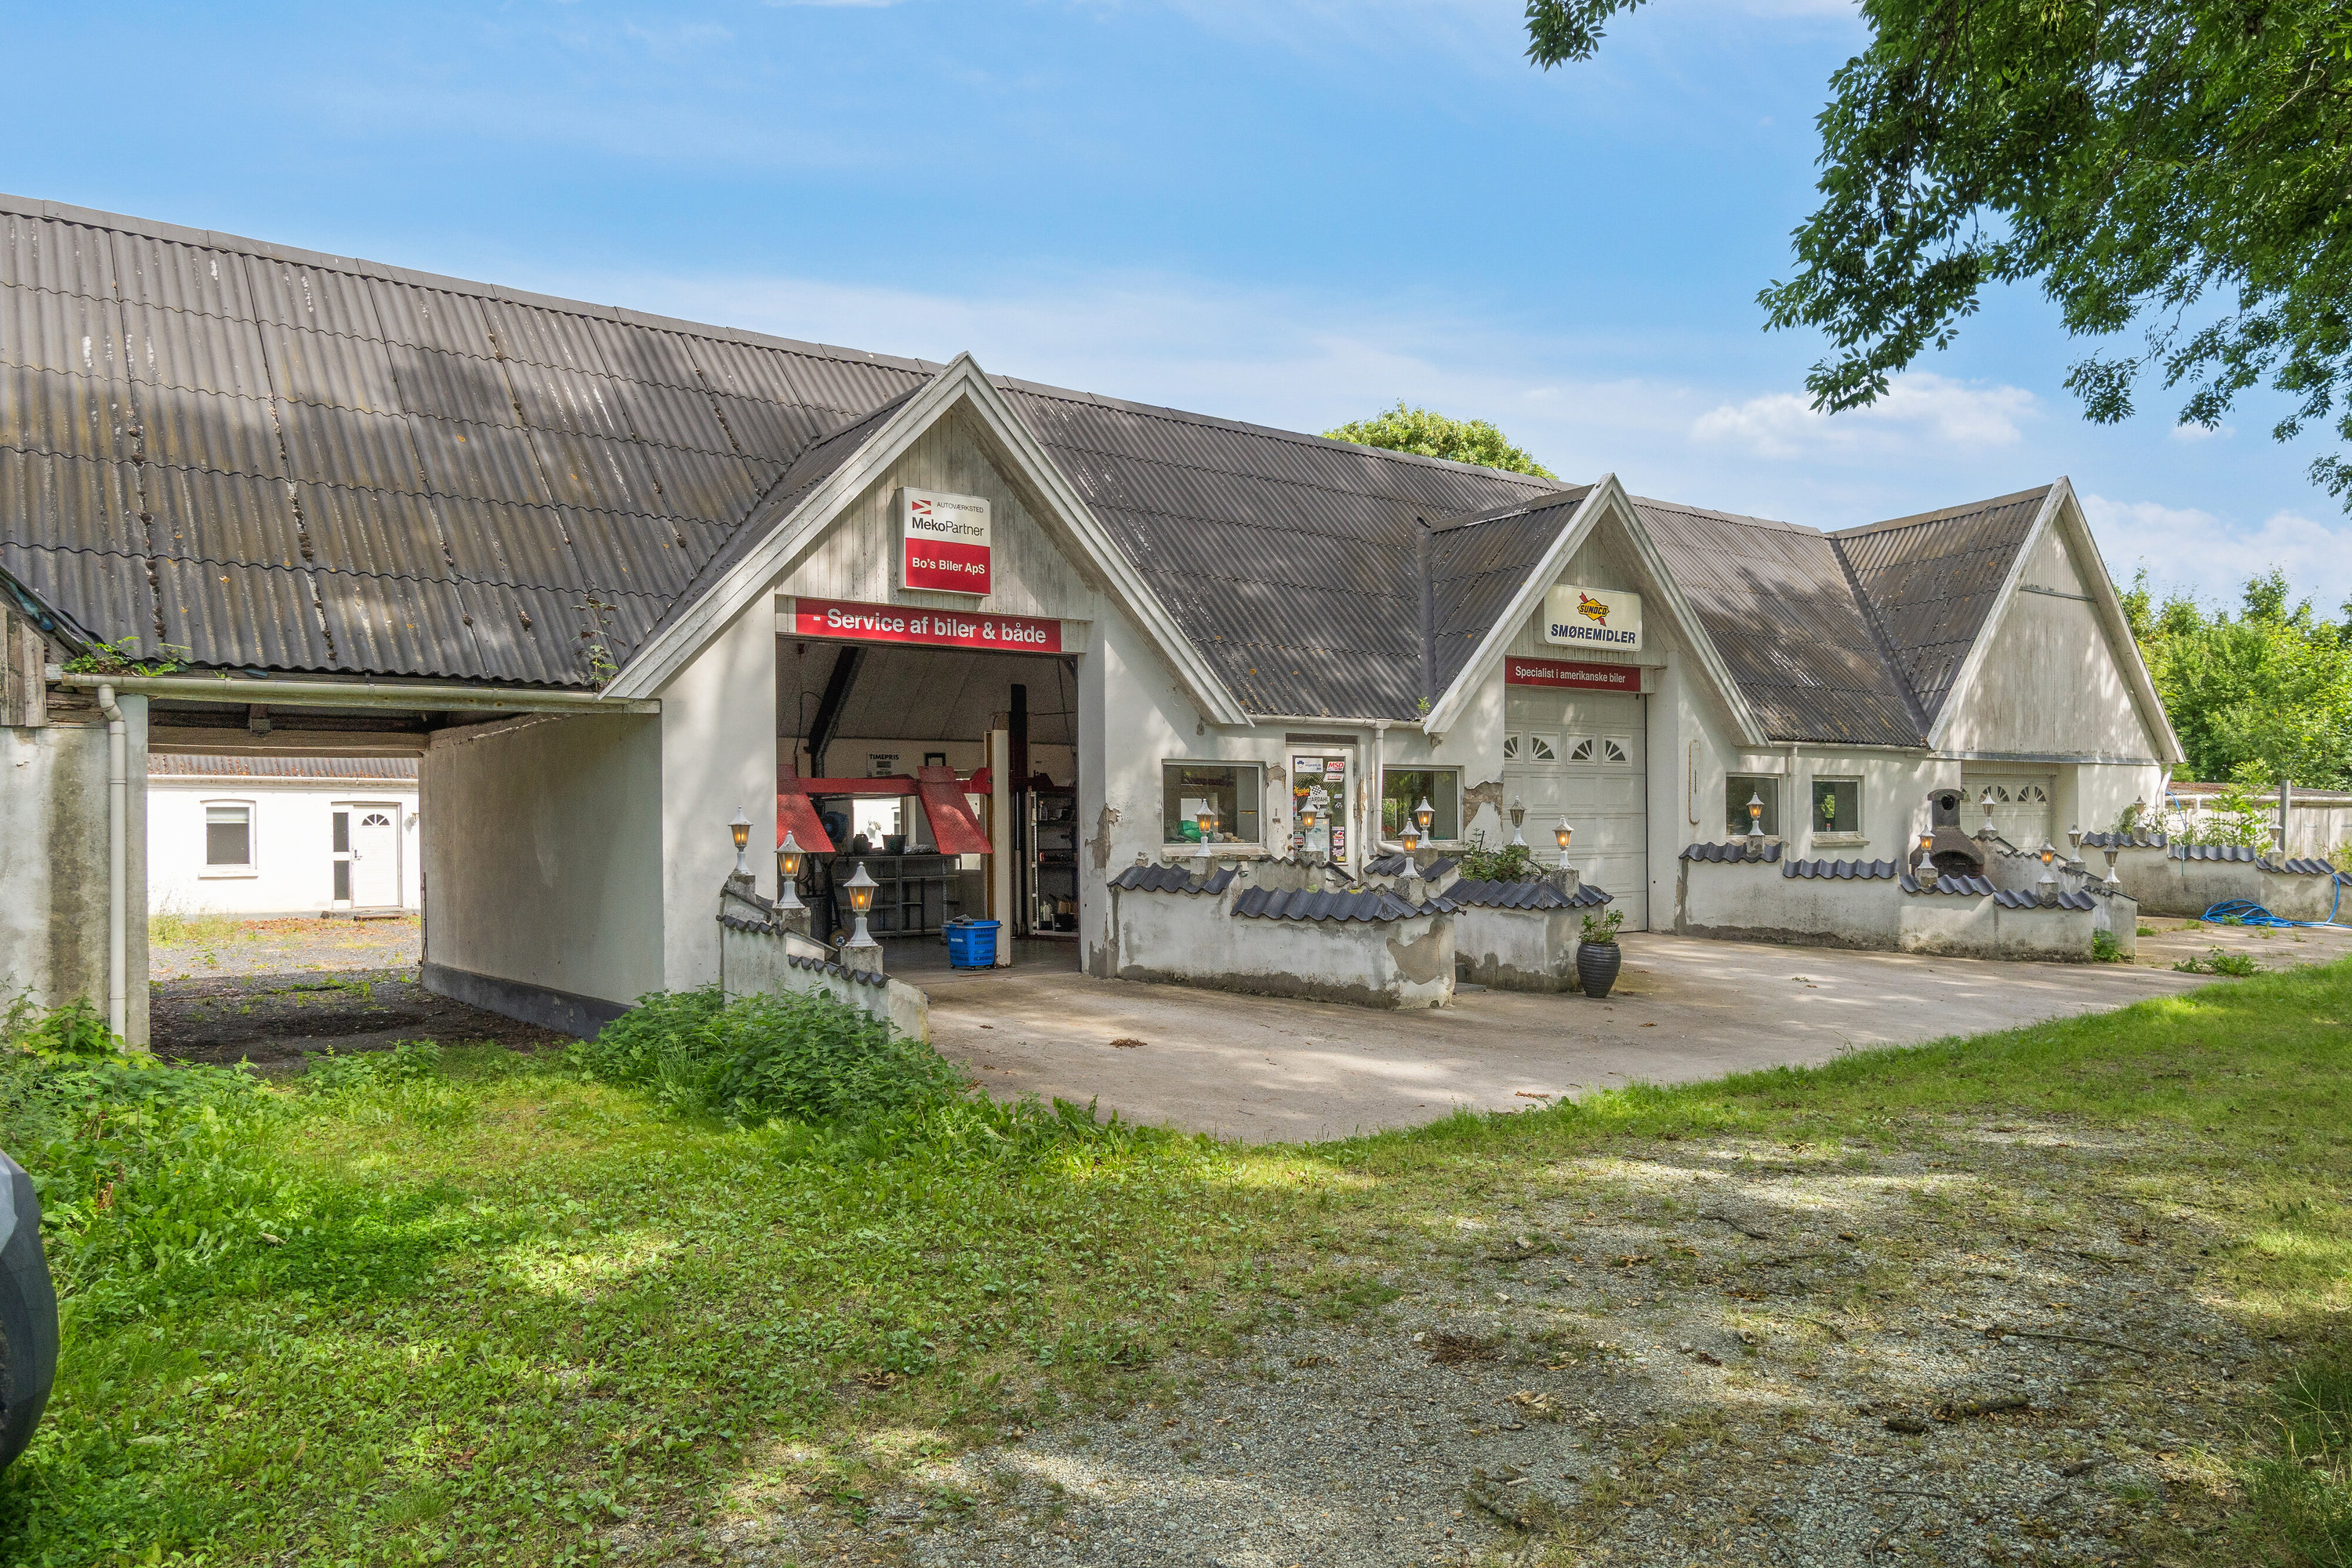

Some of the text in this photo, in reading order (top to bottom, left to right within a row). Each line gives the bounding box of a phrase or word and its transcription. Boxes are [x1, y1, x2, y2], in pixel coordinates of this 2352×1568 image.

[937, 502, 984, 513] AUTOVÆRKSTED
[912, 517, 984, 536] MekoPartner
[938, 559, 963, 572] Biler
[964, 562, 985, 575] ApS
[1580, 604, 1607, 615] SUNOCO
[827, 608, 905, 633] Service
[909, 616, 929, 634] af
[935, 617, 977, 637] biler
[982, 622, 996, 640] &
[1001, 622, 1047, 644] både
[1551, 624, 1635, 644] SMØREMIDLER
[1515, 666, 1626, 683] Specialist i amerikanske biler
